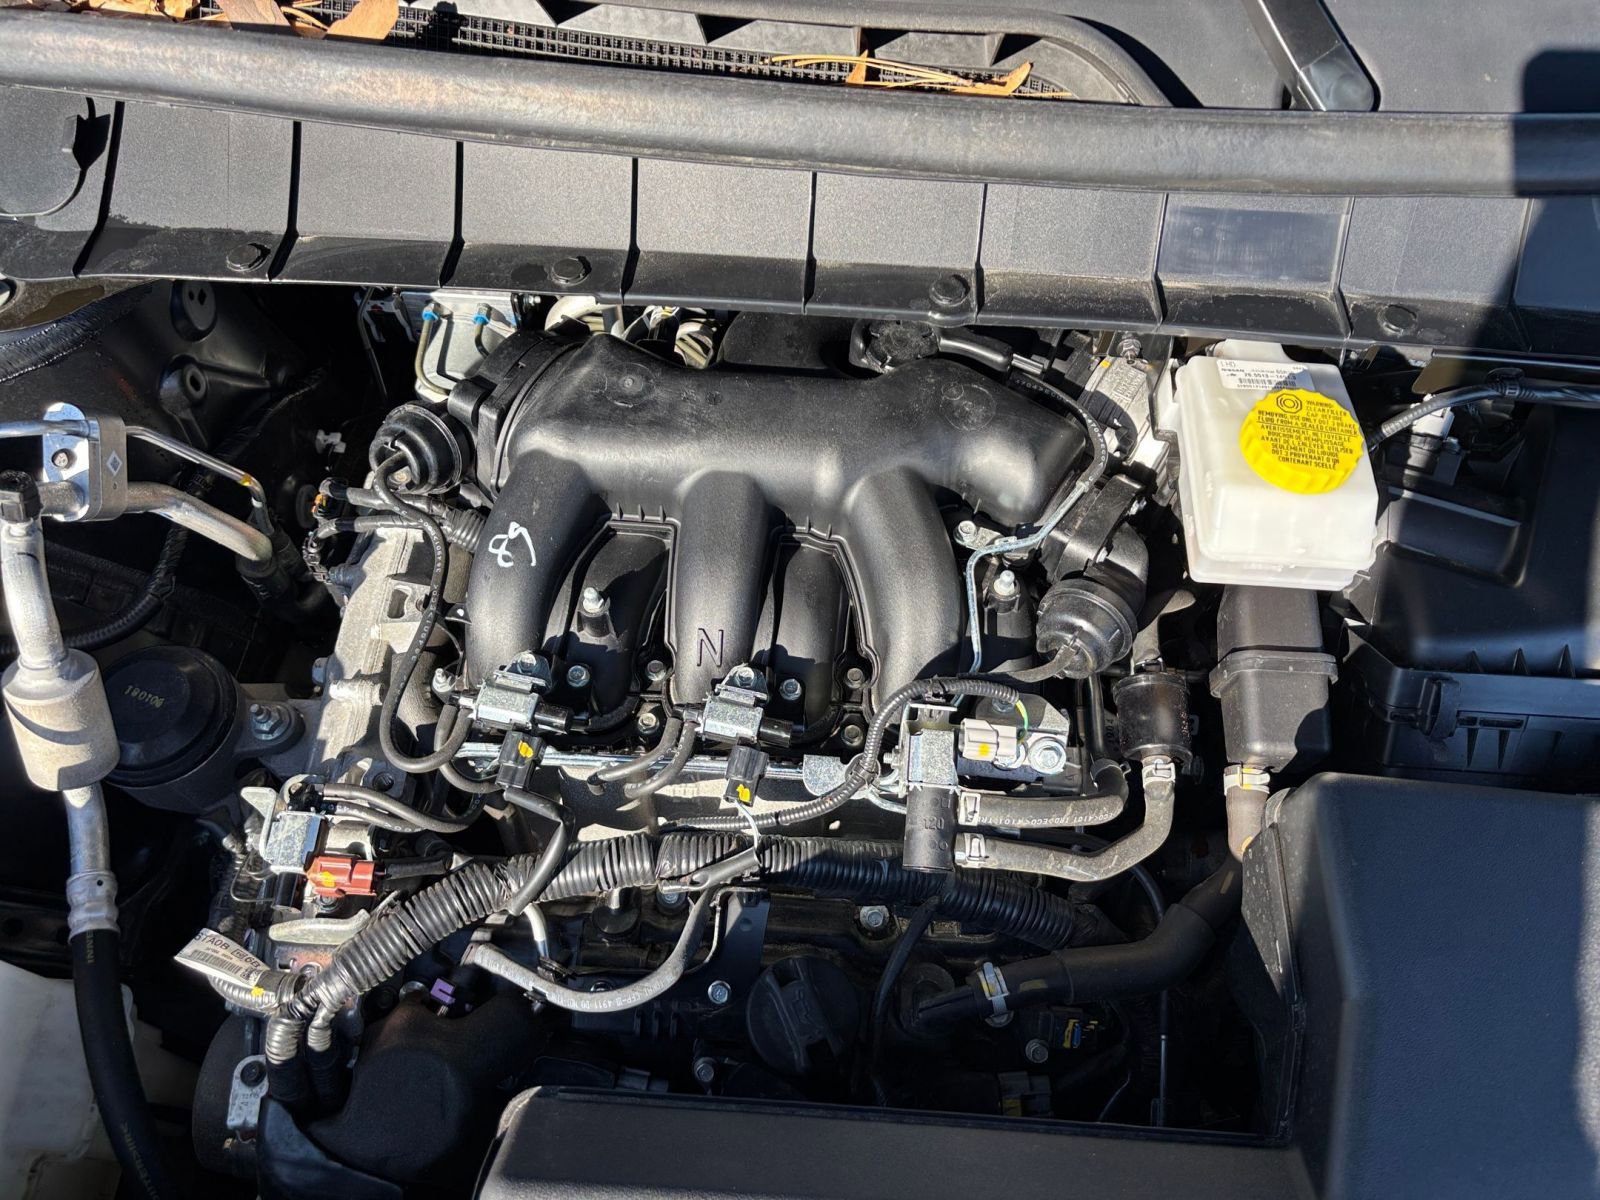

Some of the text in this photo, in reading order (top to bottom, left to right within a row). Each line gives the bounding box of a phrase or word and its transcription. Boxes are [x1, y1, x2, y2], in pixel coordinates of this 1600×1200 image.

[1276, 418, 1293, 426] FROM
[1301, 422, 1323, 430] SEALED
[1337, 421, 1356, 429] BRAKE
[1261, 436, 1281, 444] AVANT
[1272, 443, 1306, 453] SEULEMENT
[1278, 456, 1312, 466] CONTENANT
[1290, 452, 1325, 462] PROVENANT
[697, 627, 724, 667] N
